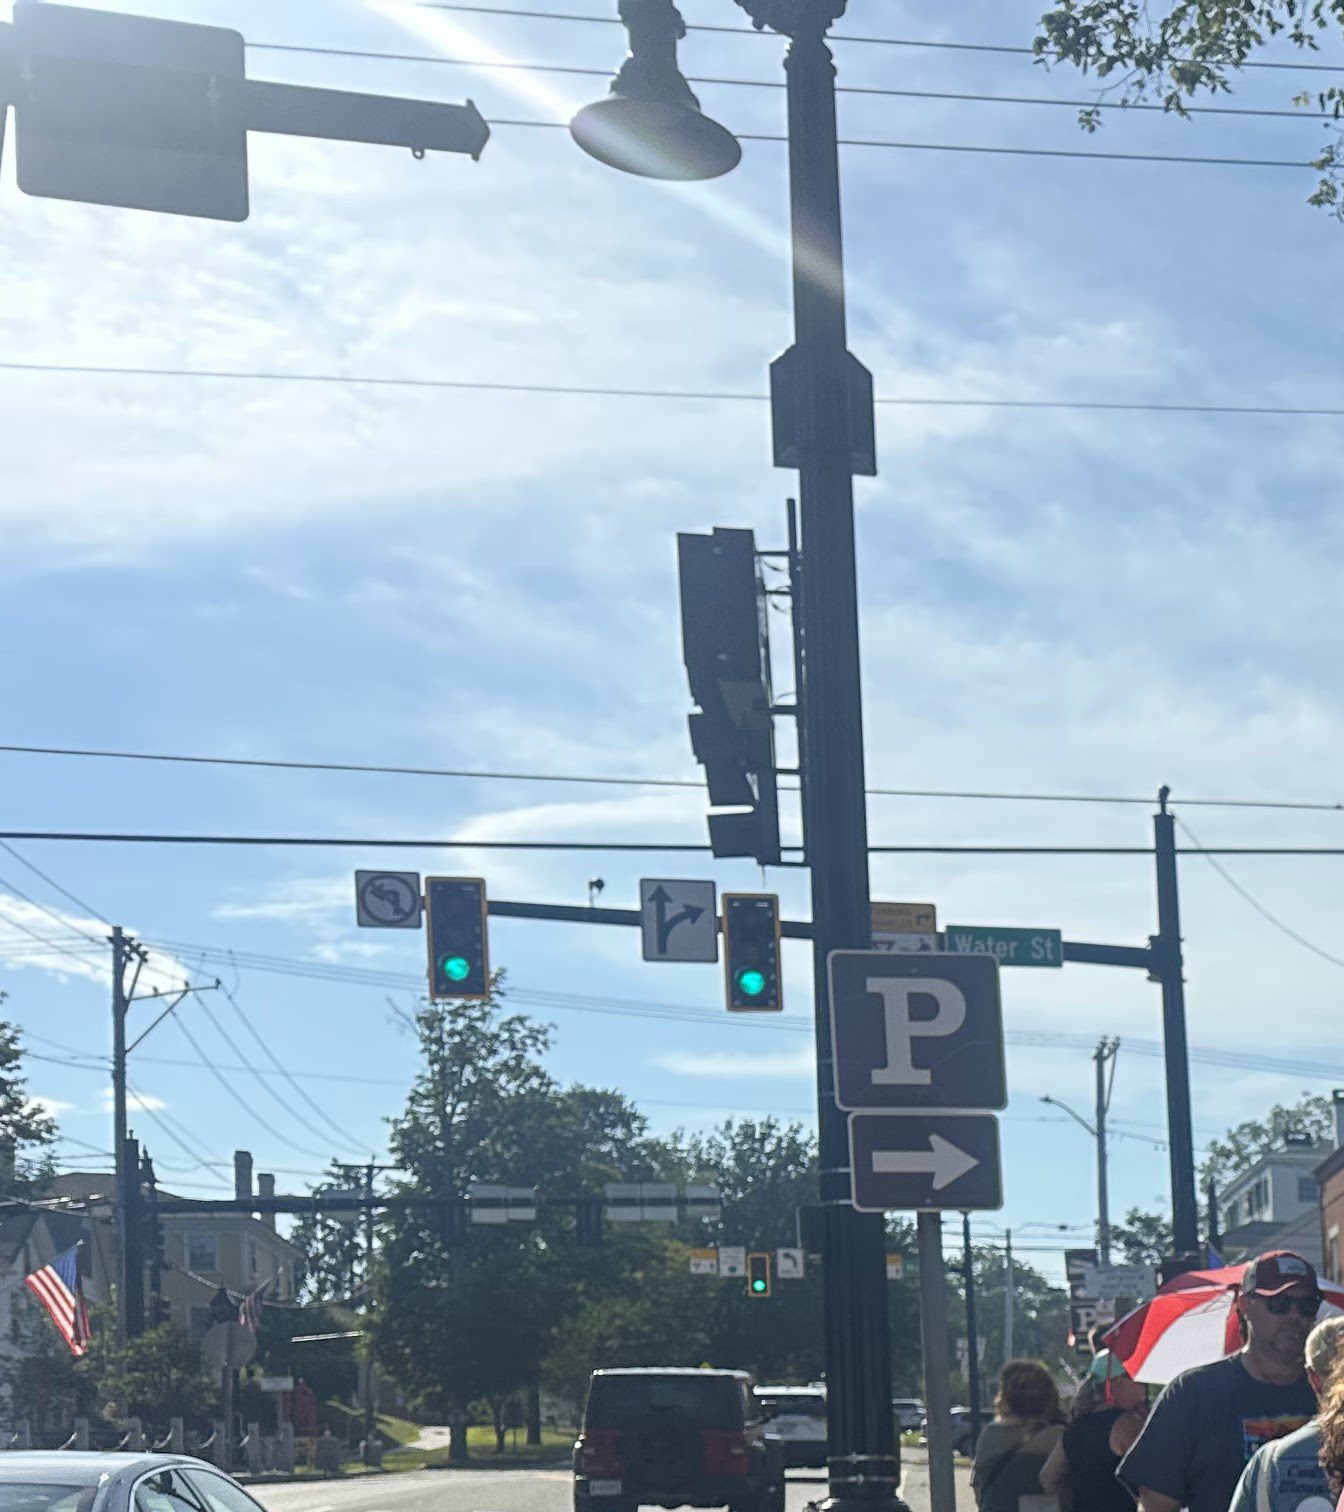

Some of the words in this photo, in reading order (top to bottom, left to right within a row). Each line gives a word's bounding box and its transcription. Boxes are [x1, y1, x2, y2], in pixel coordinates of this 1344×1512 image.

[953, 933, 1018, 959] Water
[1030, 936, 1054, 960] St
[866, 977, 967, 1086] P
